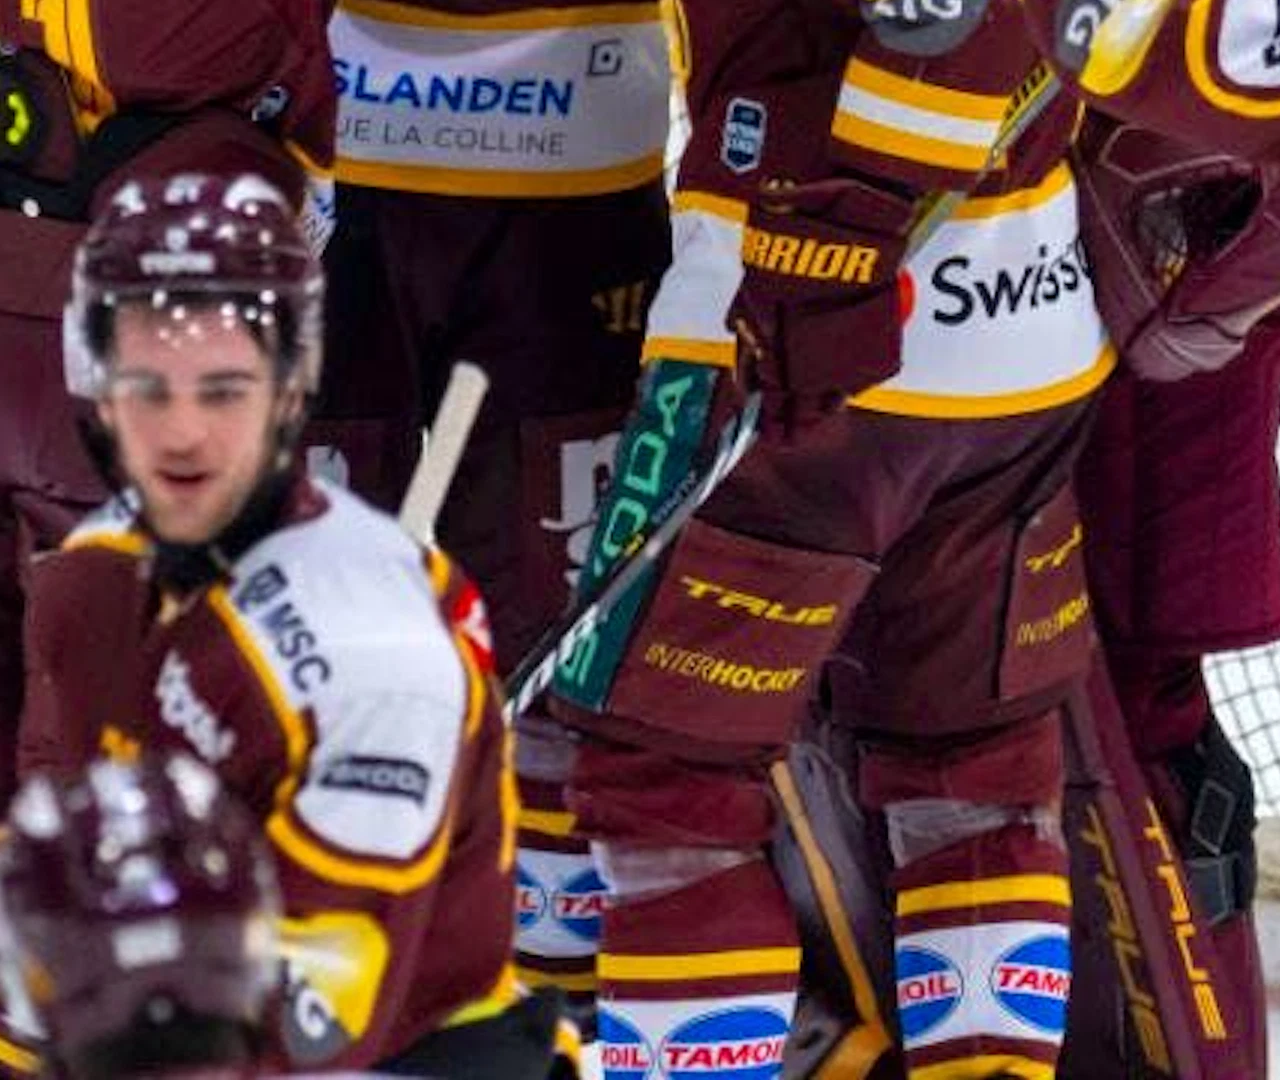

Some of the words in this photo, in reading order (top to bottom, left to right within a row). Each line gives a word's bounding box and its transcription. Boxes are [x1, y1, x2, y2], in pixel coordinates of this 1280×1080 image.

[384, 123, 422, 147] LA
[432, 125, 569, 158] COLLINE
[680, 574, 838, 626] TRUE
